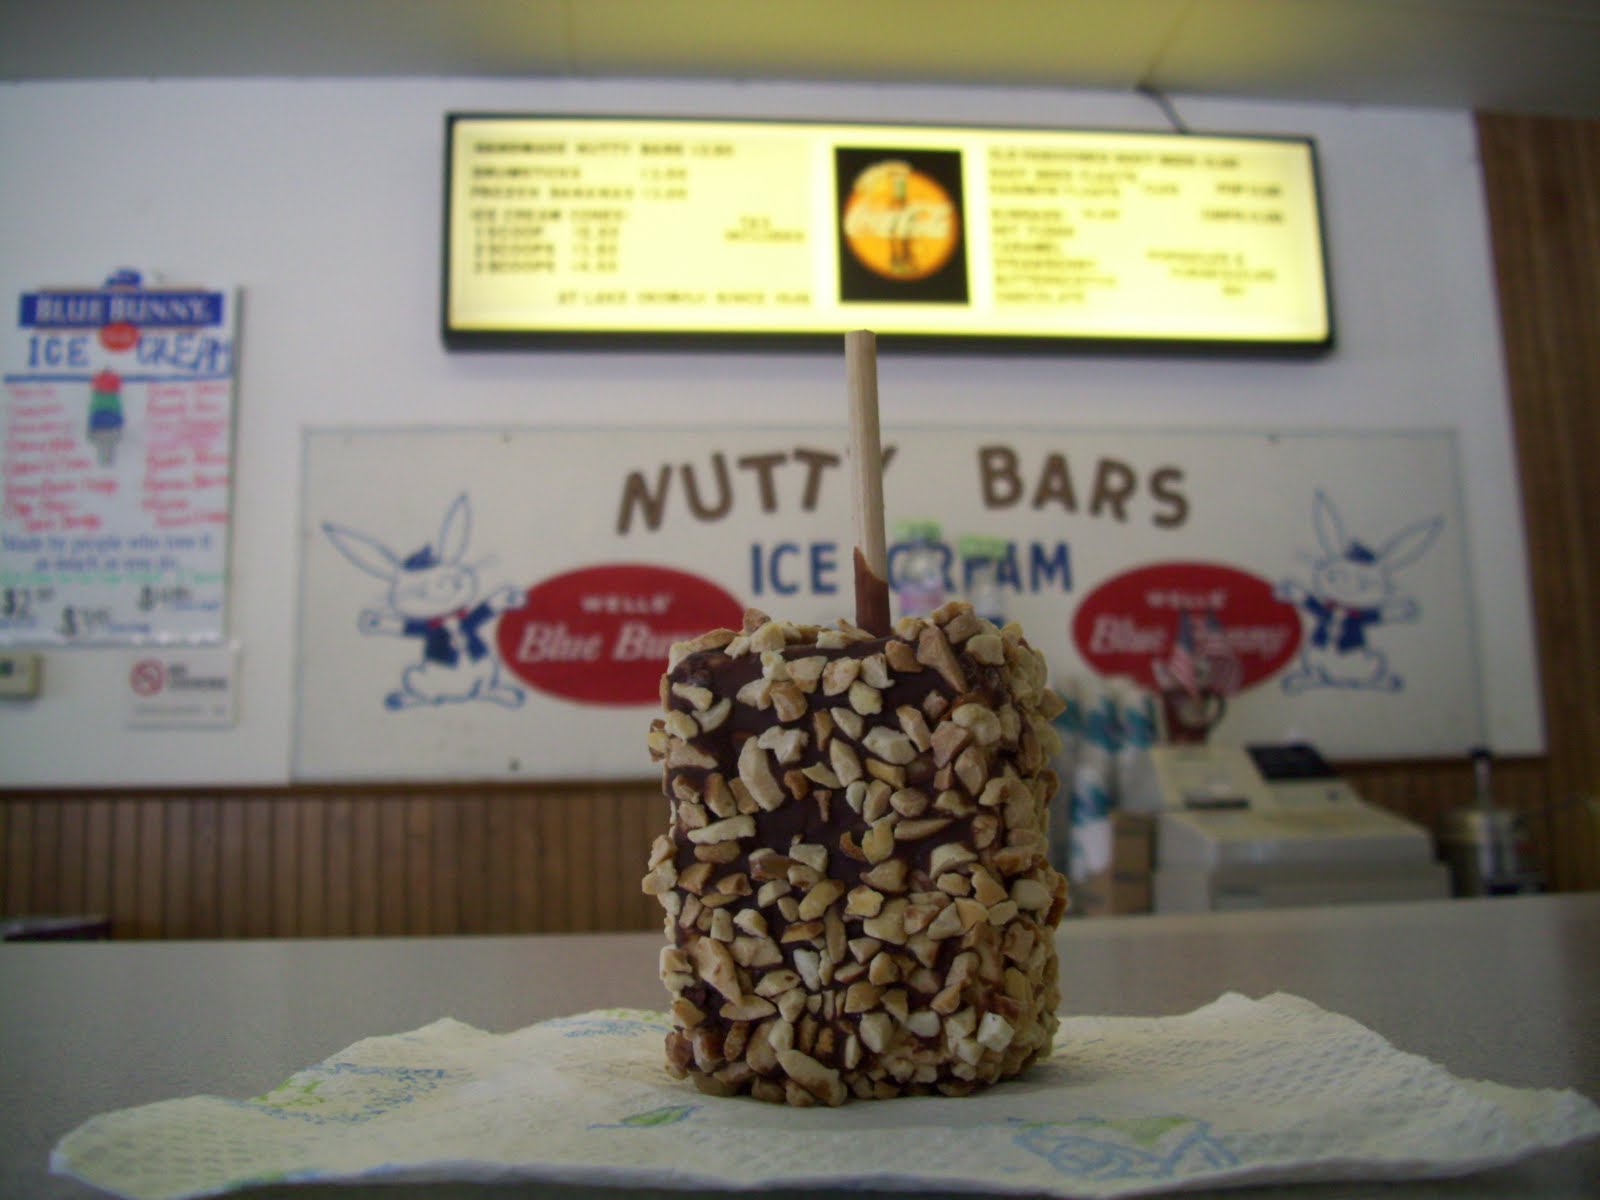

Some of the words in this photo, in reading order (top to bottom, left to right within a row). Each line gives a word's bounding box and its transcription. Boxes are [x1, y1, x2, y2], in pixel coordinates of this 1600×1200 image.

[36, 294, 102, 325] BLUE
[27, 335, 91, 368] ICE
[616, 445, 897, 536] NUTT
[978, 445, 1190, 530] BARS
[750, 541, 840, 597] ICE
[516, 620, 604, 664] Blue
[1088, 612, 1168, 656] Blue
